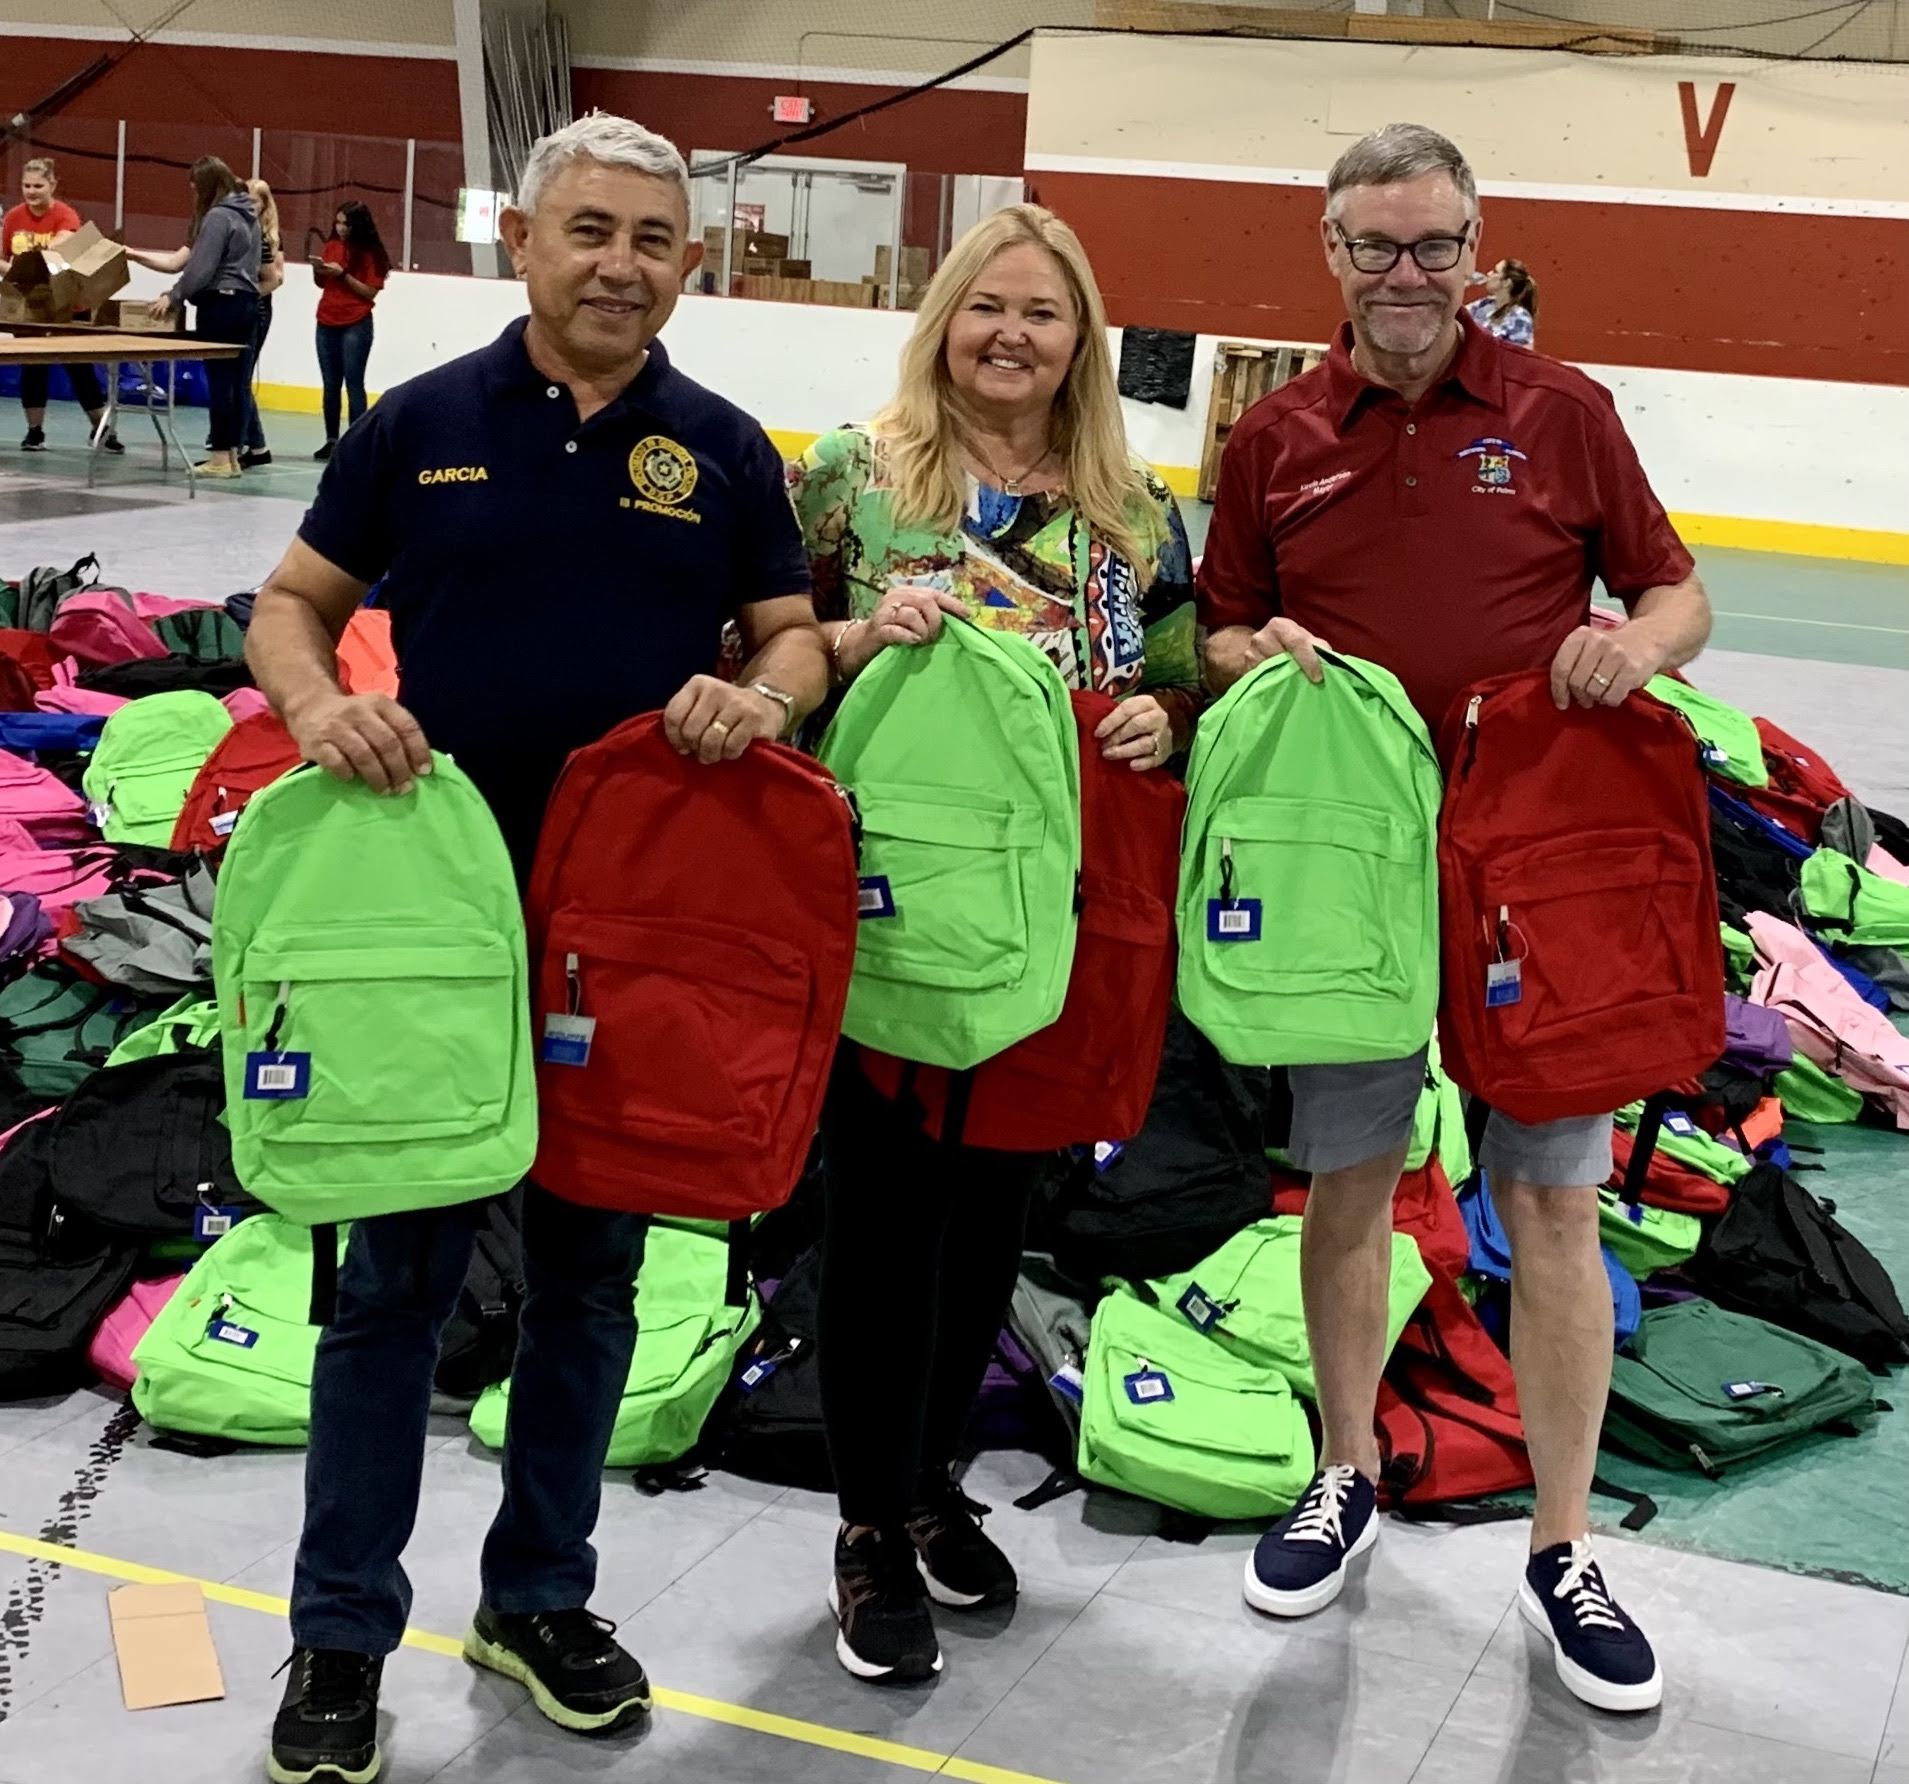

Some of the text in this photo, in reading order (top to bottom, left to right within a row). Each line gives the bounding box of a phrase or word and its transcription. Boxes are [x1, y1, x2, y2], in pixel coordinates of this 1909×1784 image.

[1677, 81, 1736, 177] V
[418, 466, 489, 485] GARCIA
[634, 500, 701, 524] PROMOCIÓN
